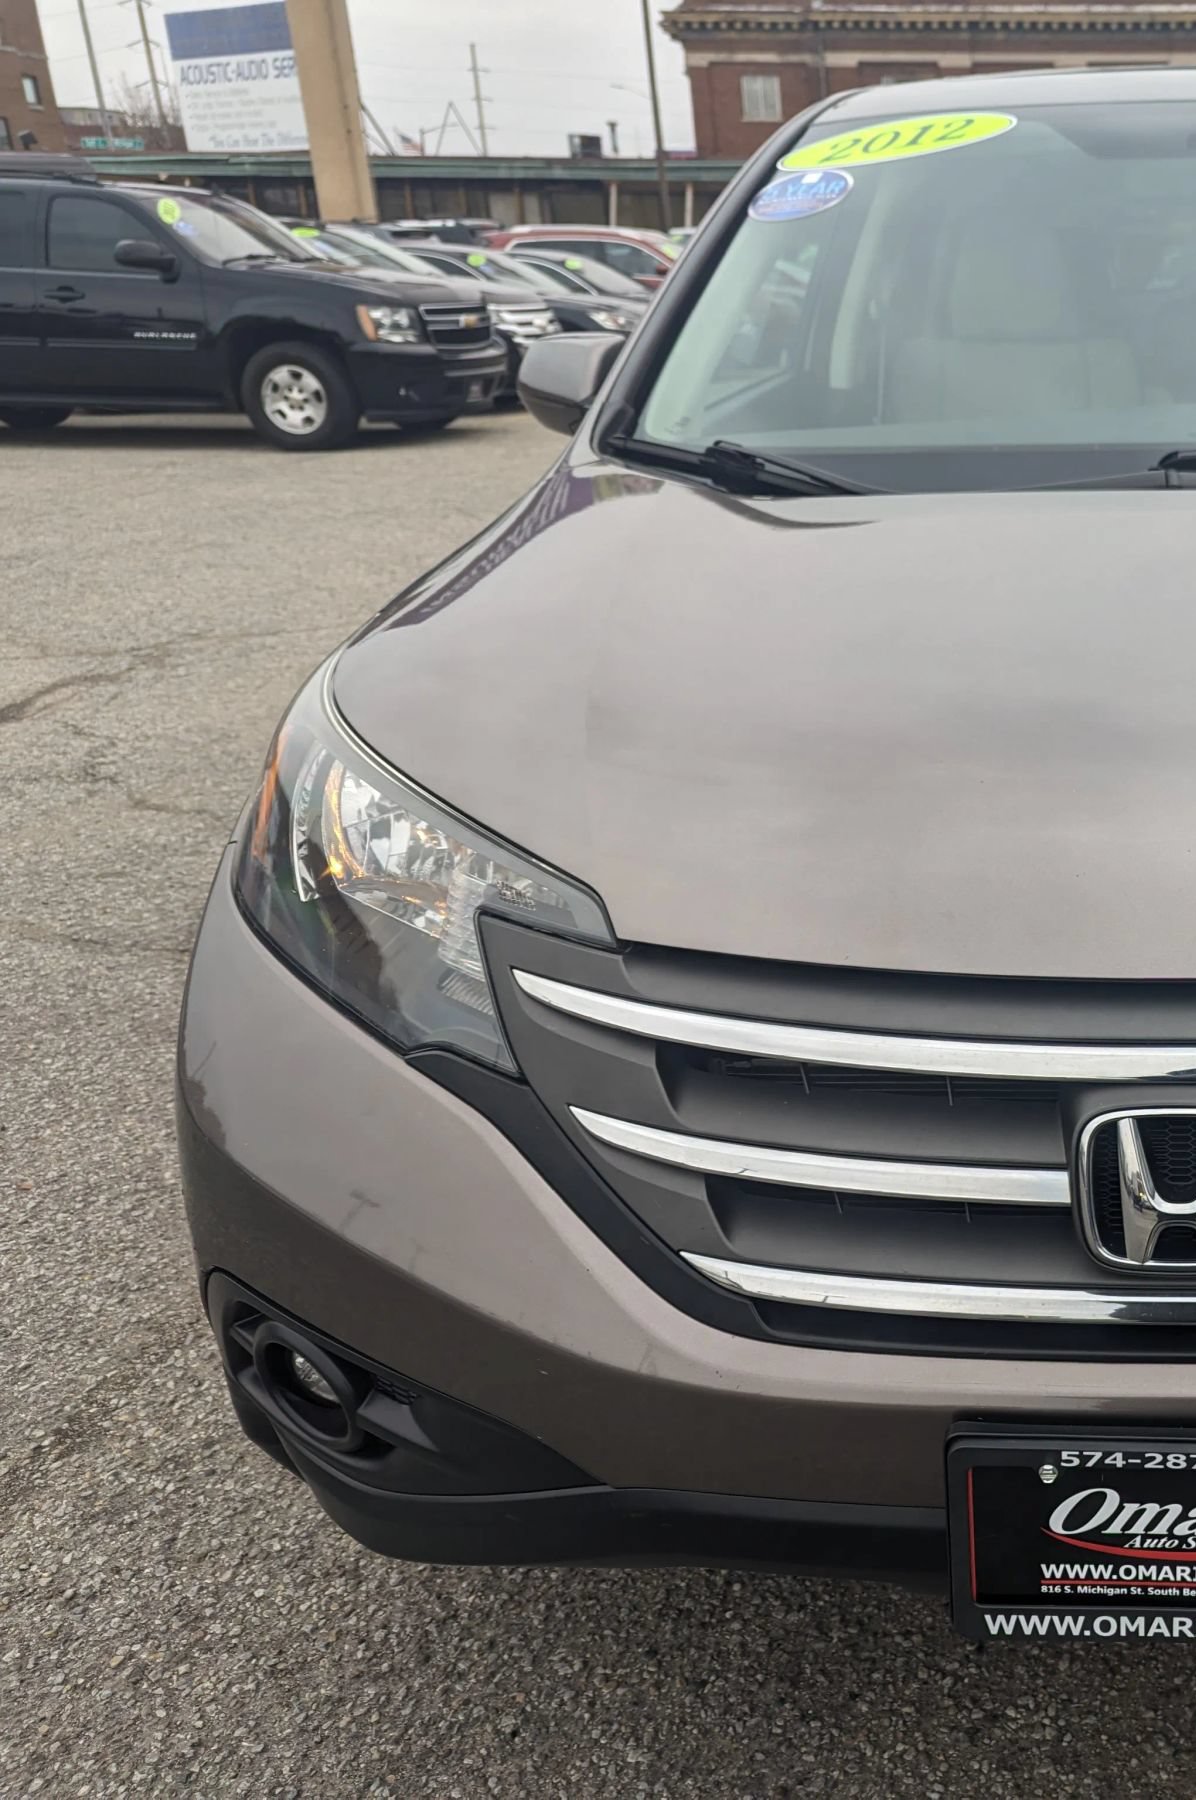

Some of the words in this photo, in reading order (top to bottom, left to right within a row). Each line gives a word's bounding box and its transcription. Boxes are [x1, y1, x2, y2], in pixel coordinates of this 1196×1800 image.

[817, 118, 975, 164] 2012
[1123, 1535, 1179, 1549] Auto
[1040, 1585, 1062, 1593] 816
[1064, 1585, 1074, 1594] S.
[1077, 1585, 1128, 1597] Michigan
[1130, 1587, 1145, 1595] St.
[1147, 1587, 1180, 1596] South
